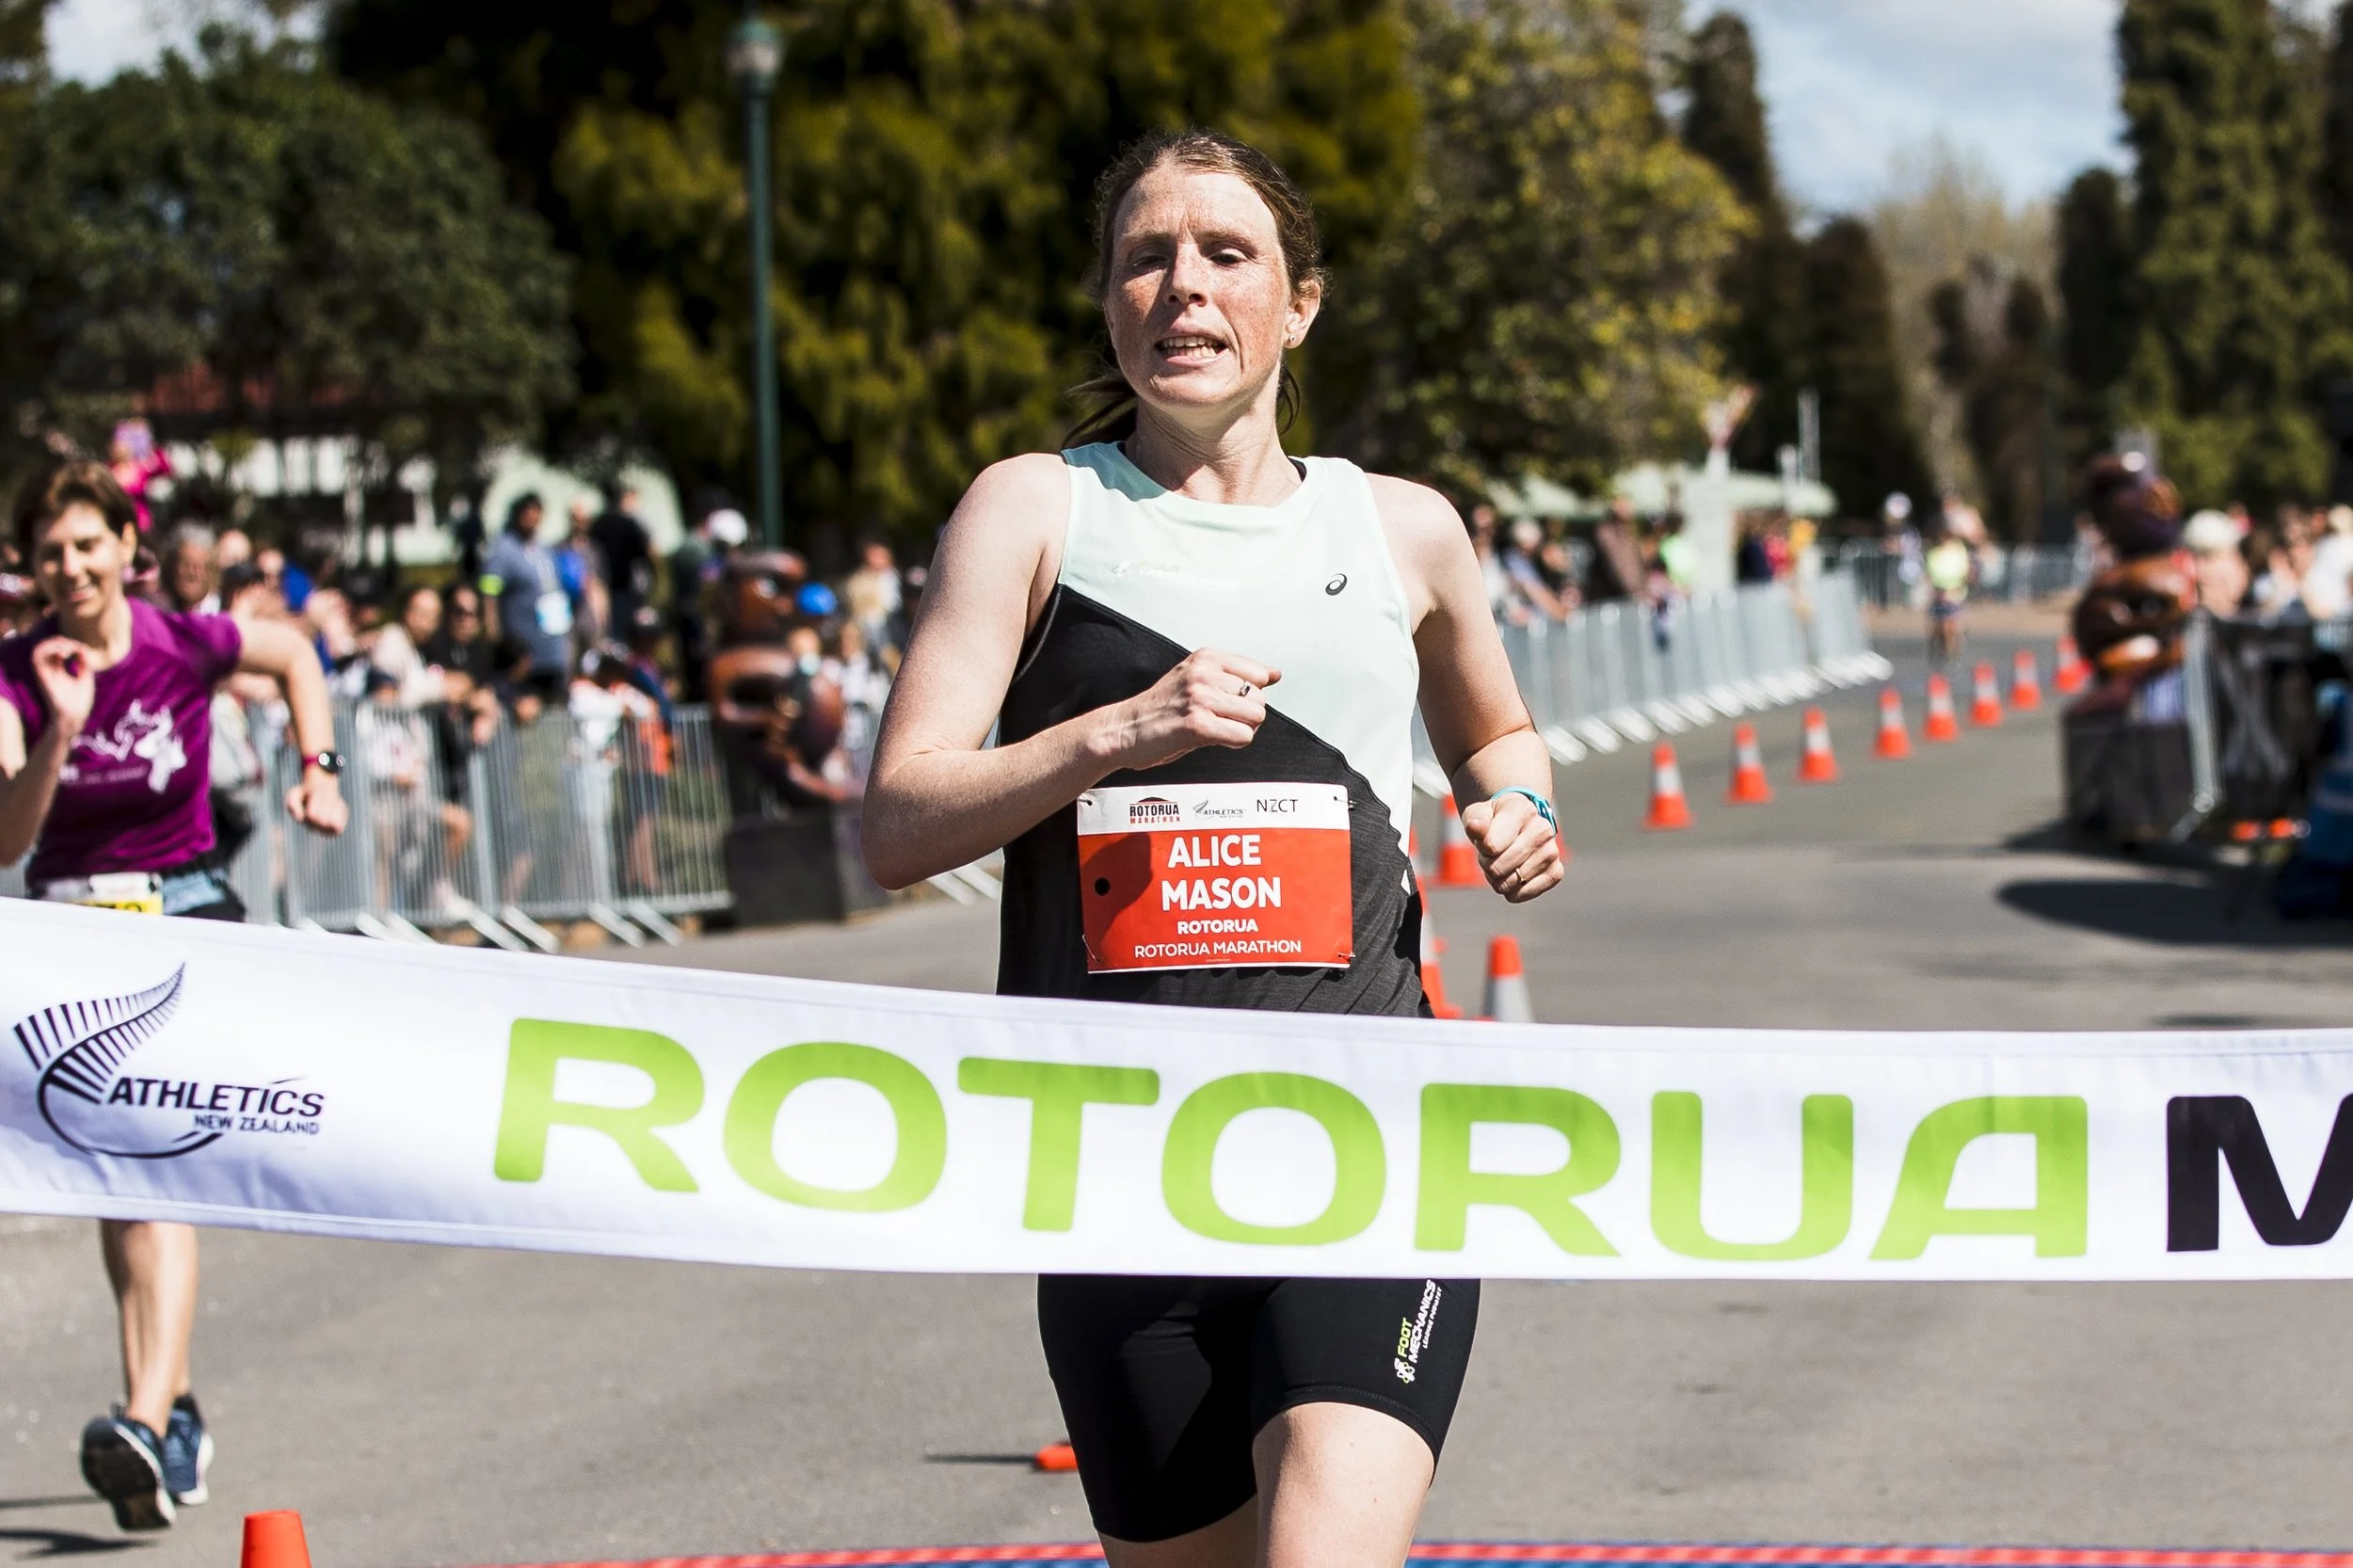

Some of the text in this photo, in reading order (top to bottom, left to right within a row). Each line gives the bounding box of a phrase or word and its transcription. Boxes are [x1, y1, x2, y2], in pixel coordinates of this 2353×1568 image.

[1129, 805, 1179, 817] ROTORUA
[1257, 799, 1298, 812] NZCT
[1129, 816, 1180, 824] MARATHON
[1167, 835, 1262, 868] ALICE
[1161, 877, 1282, 911] MASON
[1177, 919, 1258, 935] ROTORUA
[1134, 939, 1302, 958] ROTORUA MARATHON
[108, 1078, 325, 1117] ATHLETICS
[194, 1114, 320, 1135] NEW ZEALAND
[493, 1017, 2089, 1261] ROTORUA
[1408, 1279, 1436, 1363] MECHANICS
[1398, 1318, 1412, 1357] FOOT
